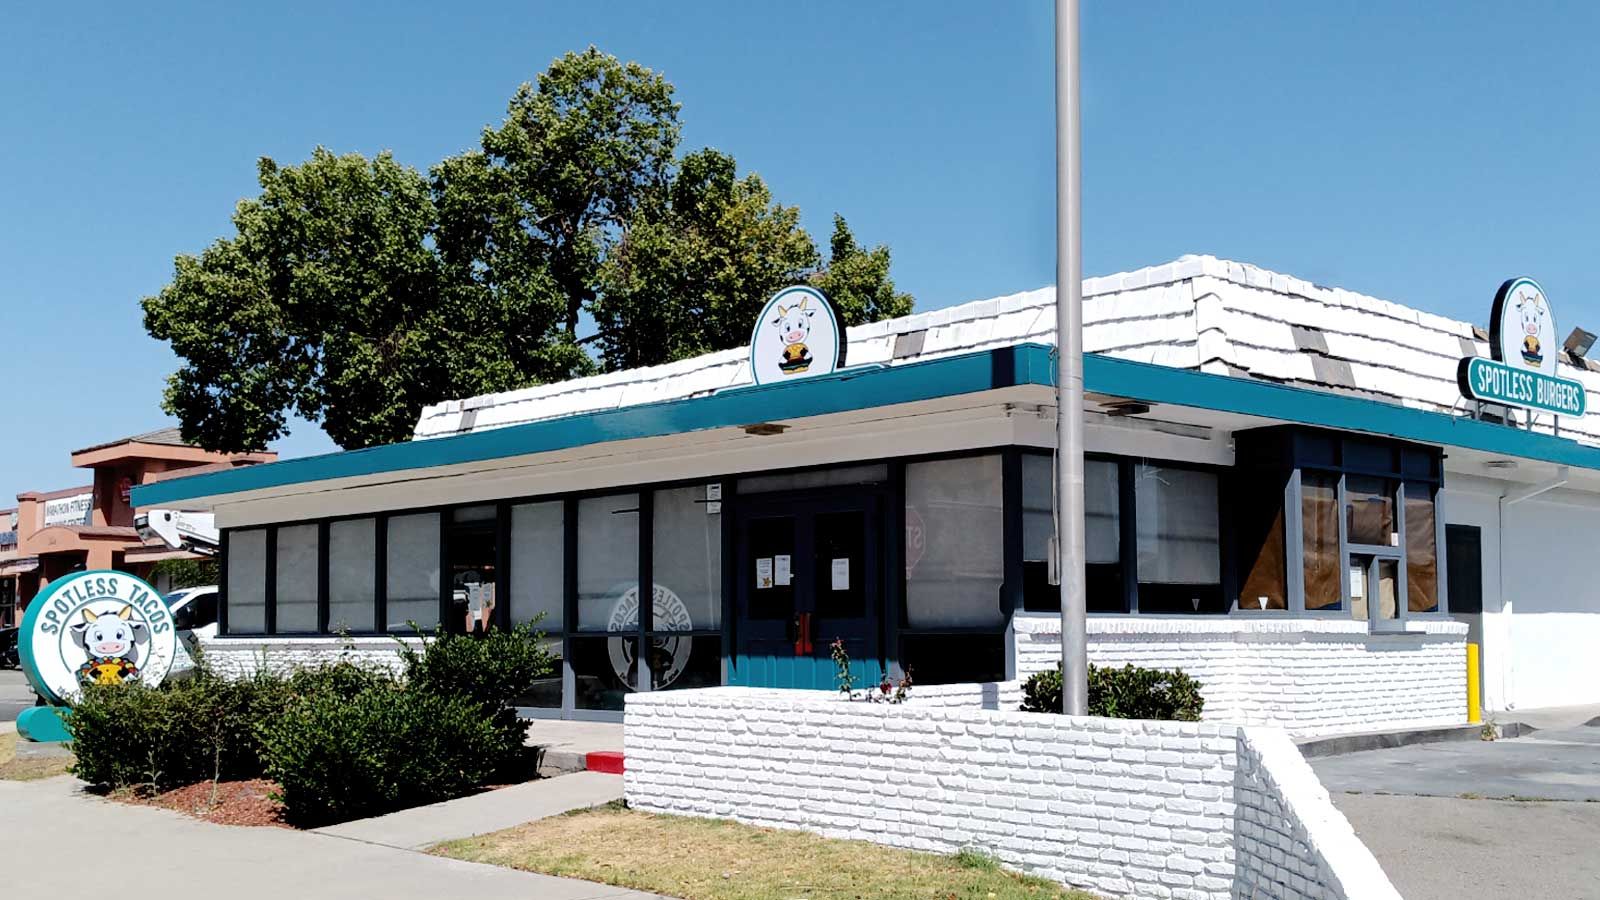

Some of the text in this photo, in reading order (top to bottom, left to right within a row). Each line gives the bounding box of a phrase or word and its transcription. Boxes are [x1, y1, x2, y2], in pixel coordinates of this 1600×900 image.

[1478, 364, 1580, 412] SPOTLESS BURGERS
[40, 577, 170, 636] SPOTLESS TACOS
